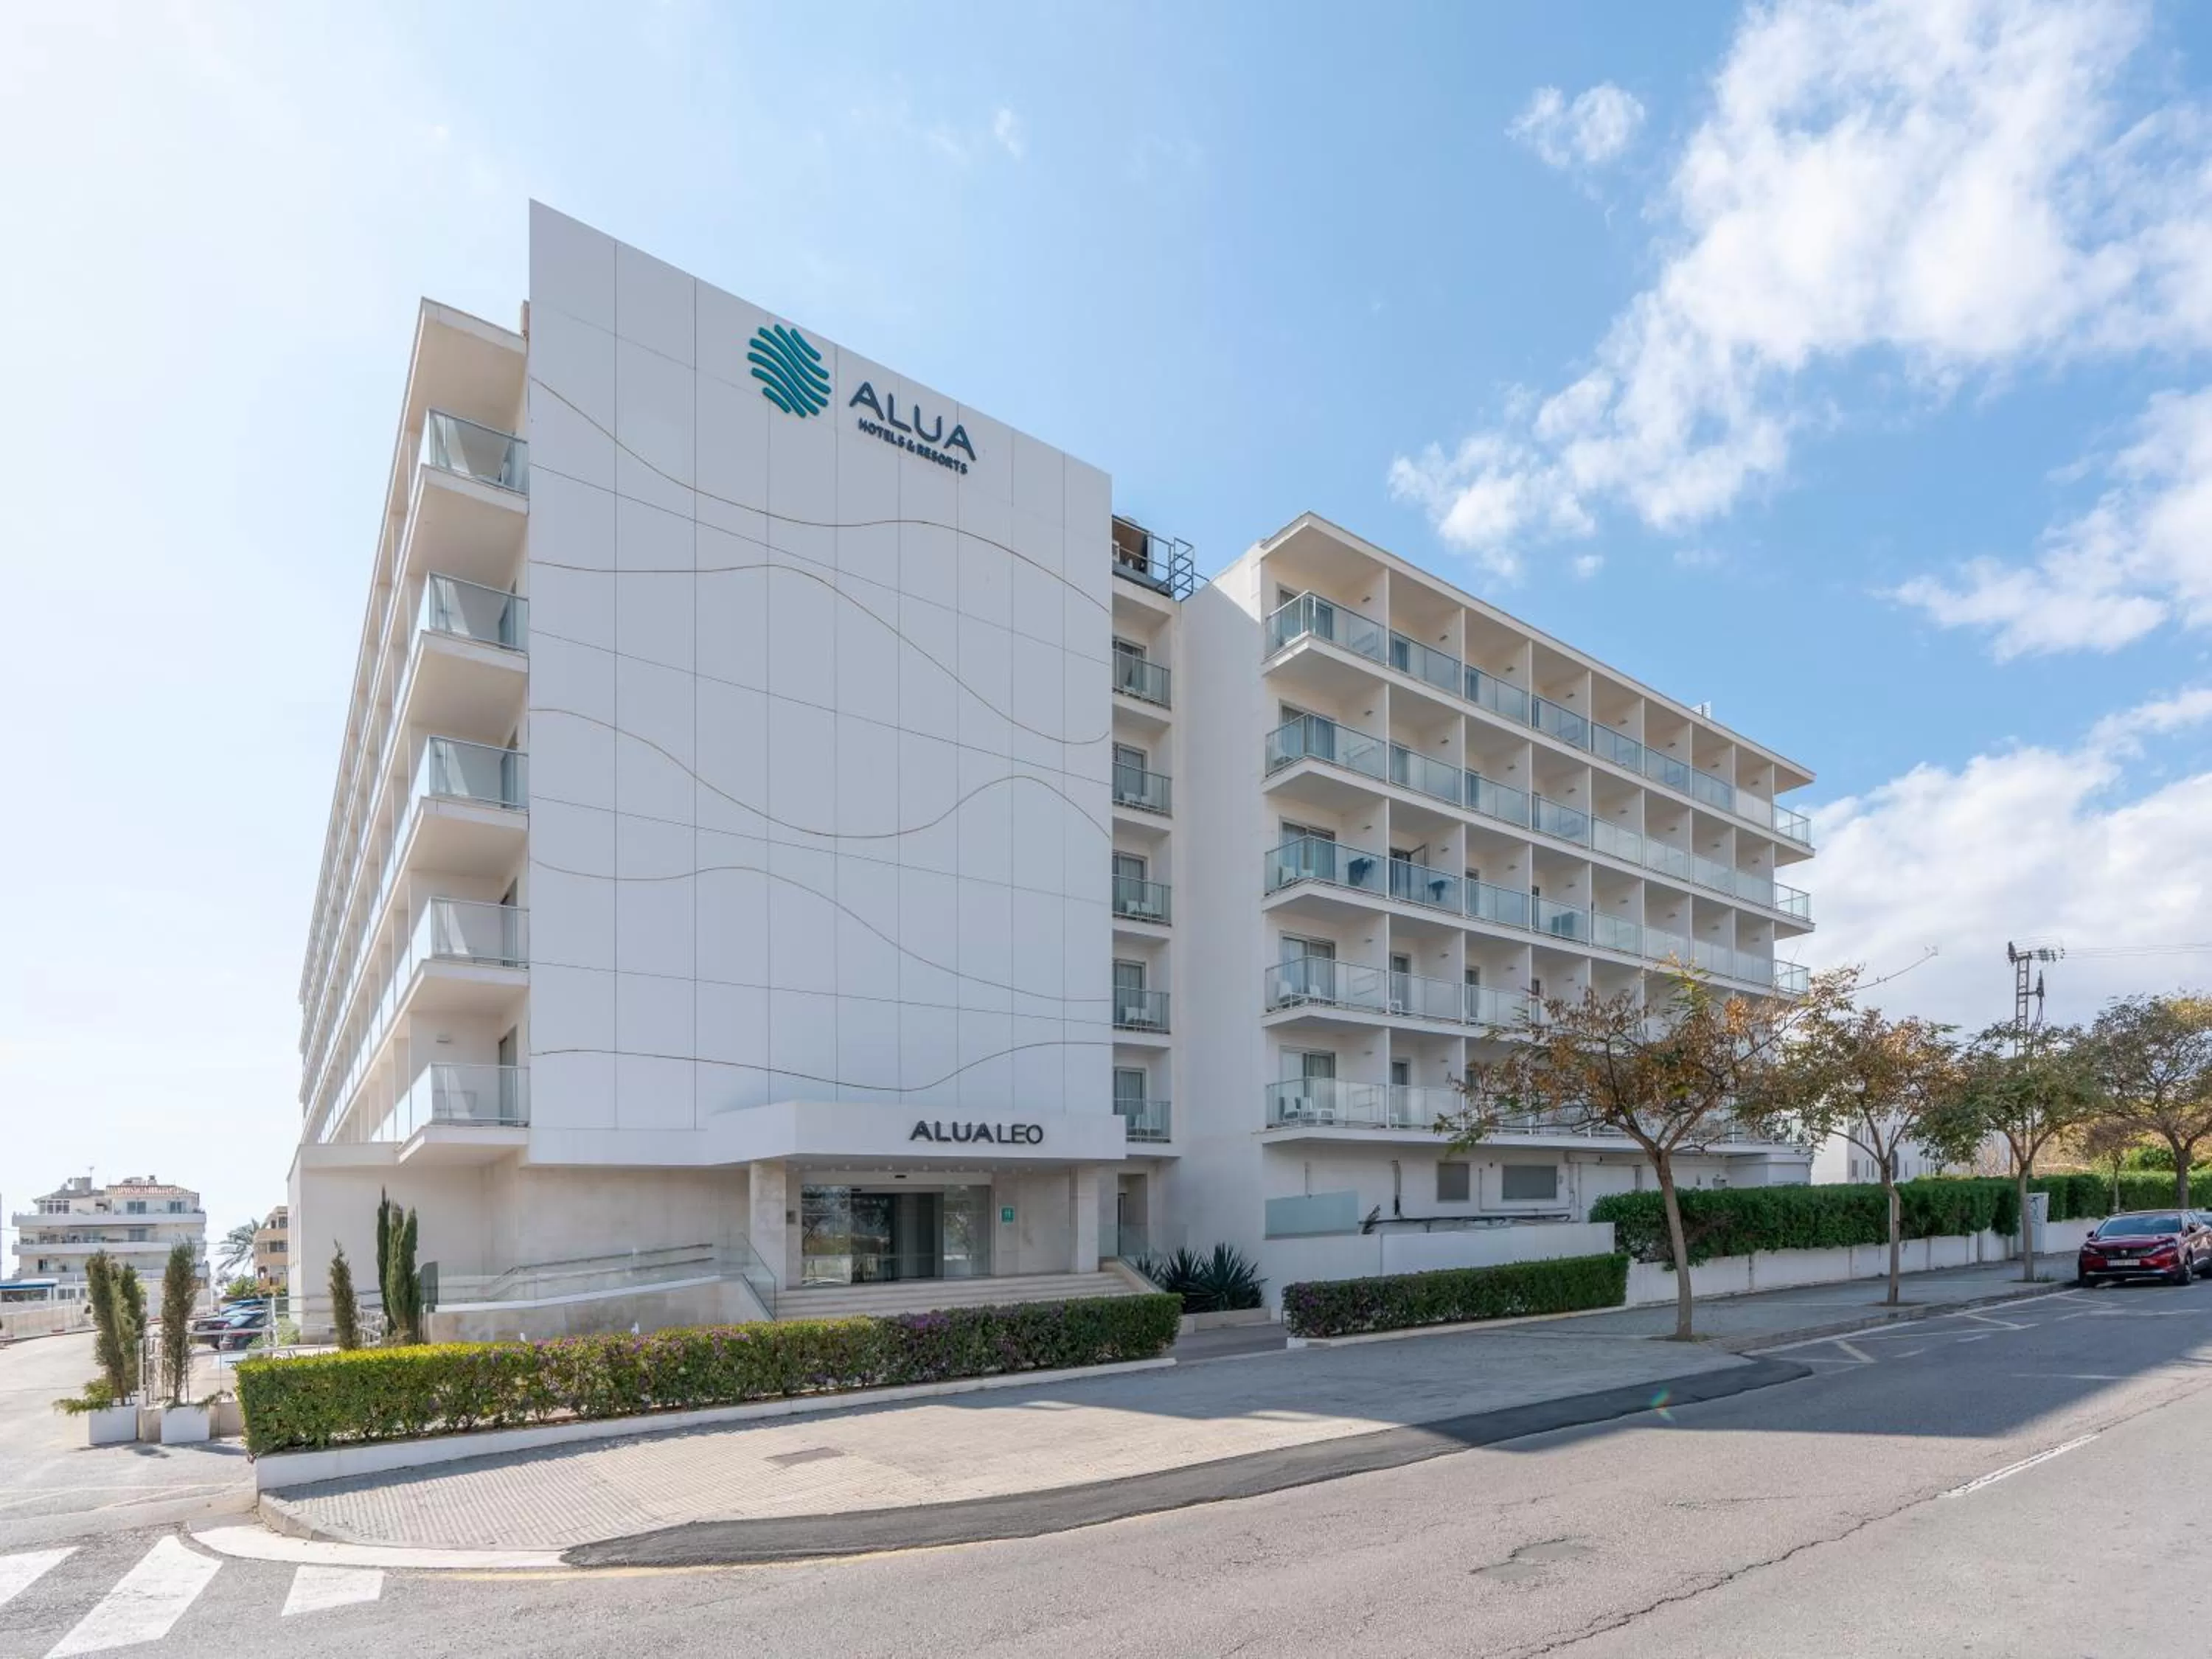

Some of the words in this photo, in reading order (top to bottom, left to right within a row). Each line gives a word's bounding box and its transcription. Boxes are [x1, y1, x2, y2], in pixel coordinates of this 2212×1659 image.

[849, 381, 976, 462] ALUA
[858, 417, 905, 448] HOTELS
[907, 439, 915, 453] &
[917, 443, 968, 475] RESORTS
[908, 1120, 1043, 1145] ALUALEO
